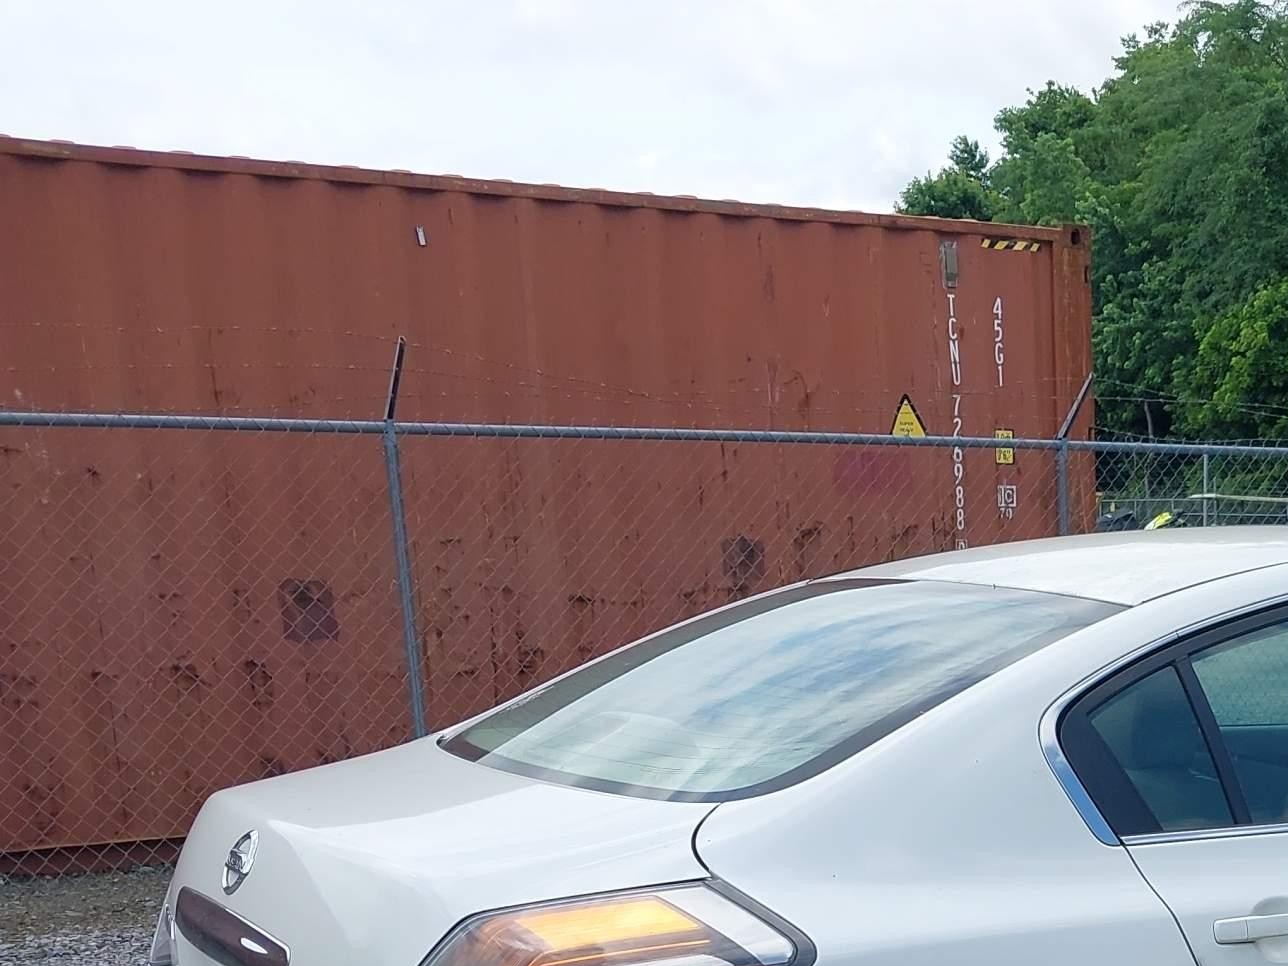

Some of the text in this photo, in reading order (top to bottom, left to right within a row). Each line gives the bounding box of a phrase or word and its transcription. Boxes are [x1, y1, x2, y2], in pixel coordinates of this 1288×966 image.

[947, 293, 961, 386] TCNU
[992, 296, 1004, 387] 45G1
[952, 394, 965, 530] 726988
